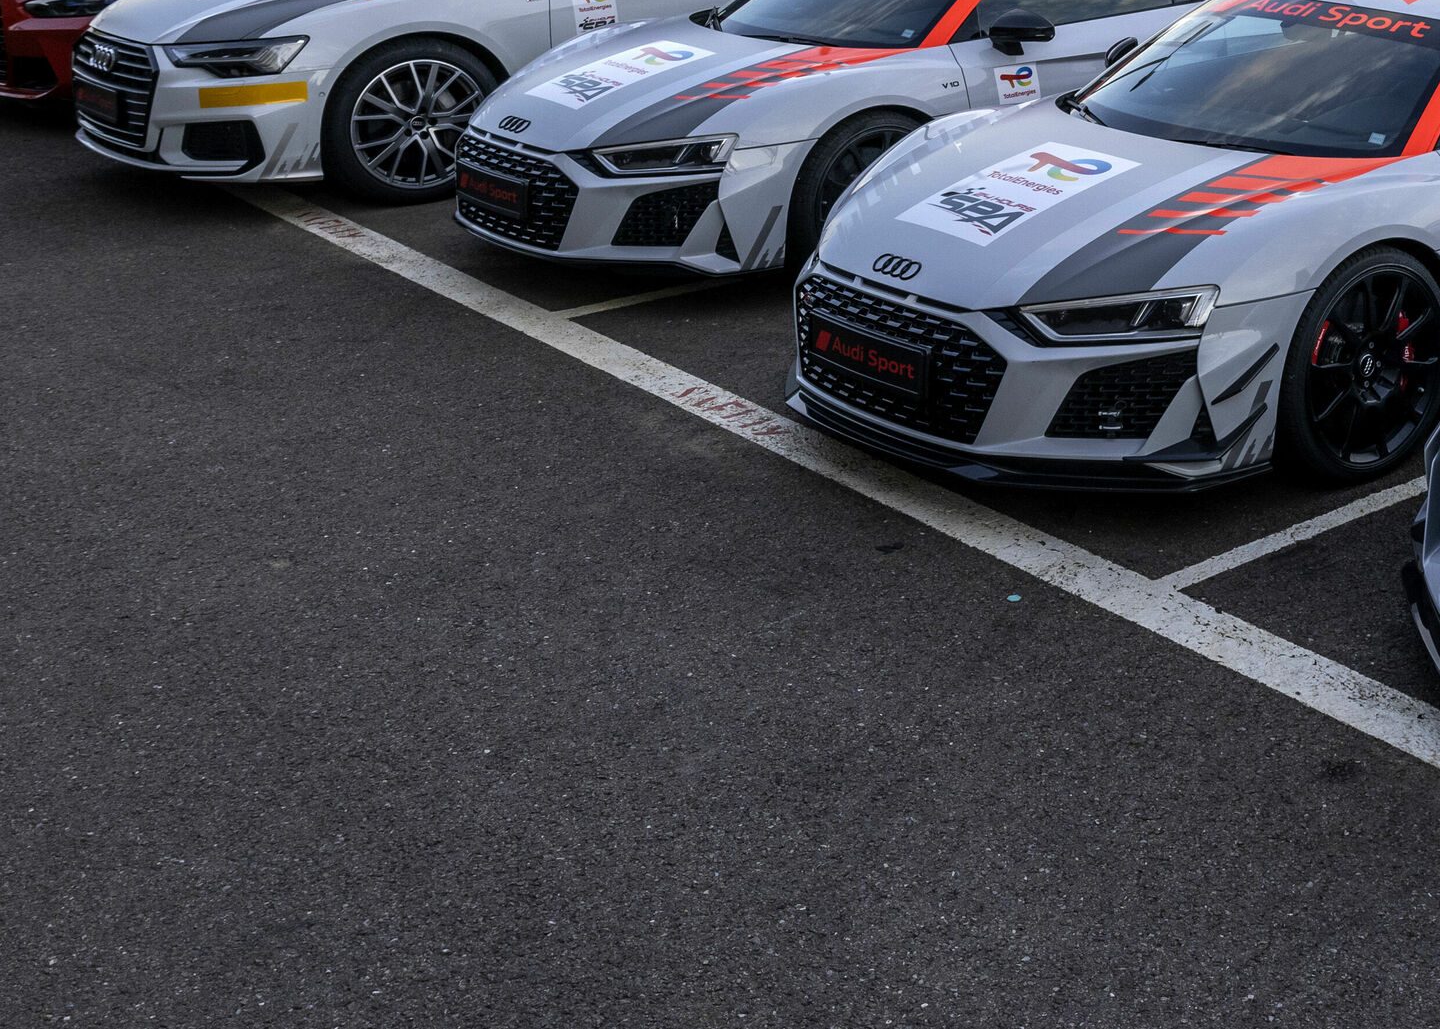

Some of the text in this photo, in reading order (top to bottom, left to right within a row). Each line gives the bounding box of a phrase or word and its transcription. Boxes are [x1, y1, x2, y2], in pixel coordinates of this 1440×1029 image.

[1318, 6, 1431, 38] Sport
[942, 80, 960, 89] V10
[987, 170, 1064, 196] TotalEnergies
[940, 194, 1025, 235] SPA
[991, 196, 1037, 213] HOURS
[832, 336, 915, 379] Audi Sport
